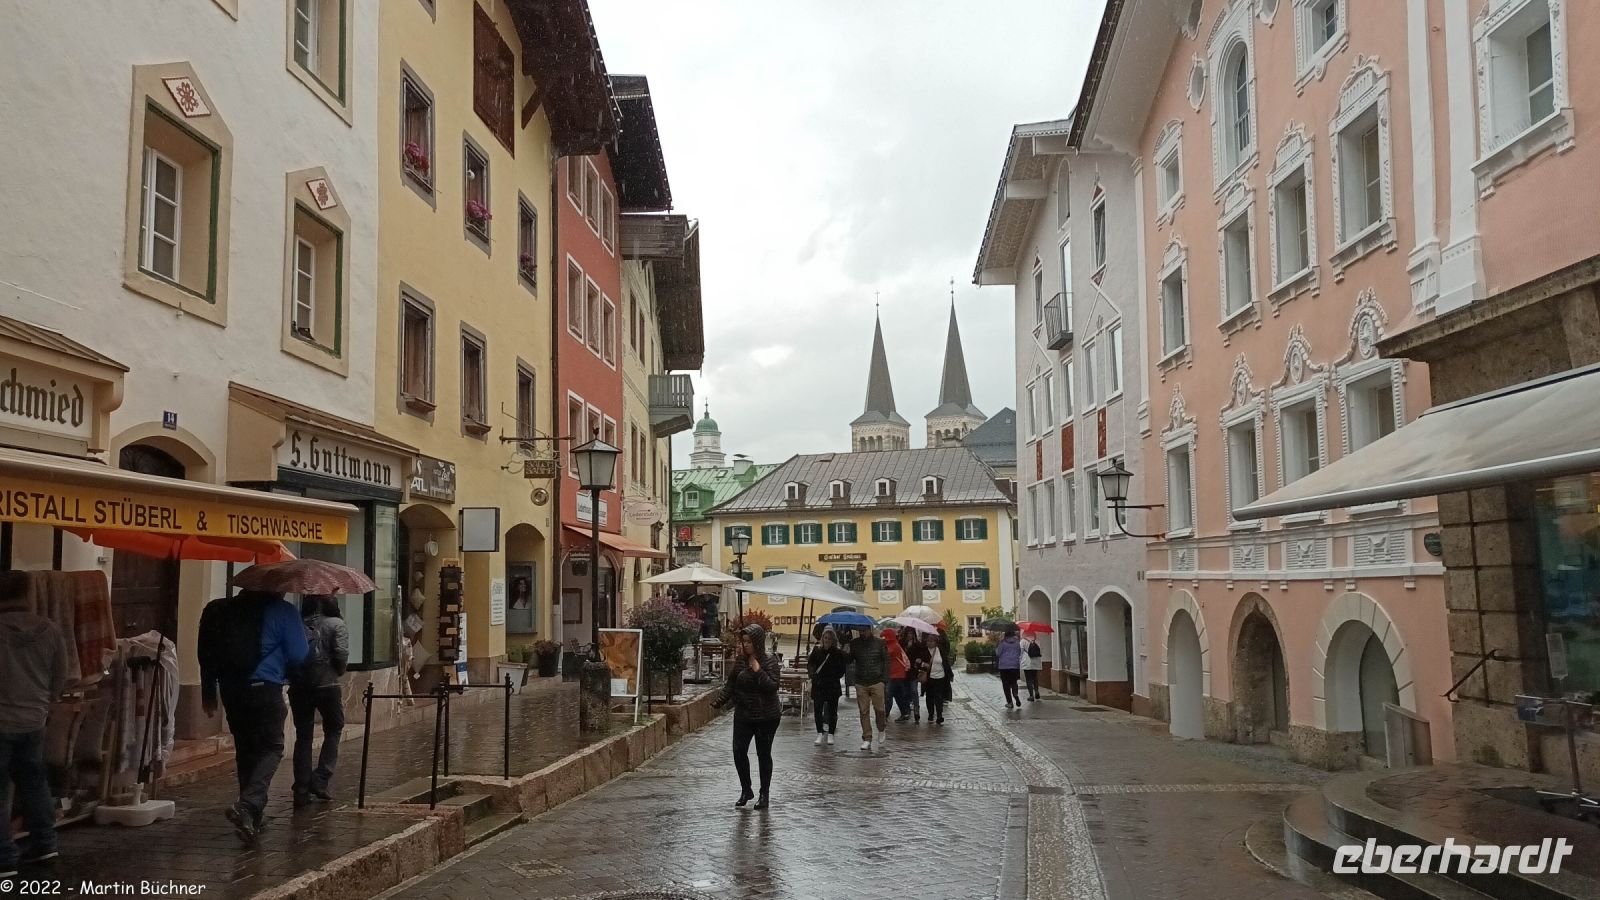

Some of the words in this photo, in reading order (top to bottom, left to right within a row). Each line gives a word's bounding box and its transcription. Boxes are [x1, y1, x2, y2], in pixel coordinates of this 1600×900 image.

[290, 430, 308, 468] S.
[310, 436, 391, 486] Guttmann
[0, 489, 87, 524] ISTALL
[94, 498, 182, 530] STÜBERL
[196, 510, 208, 531] &
[227, 514, 323, 540] TISCHWÄSCHE
